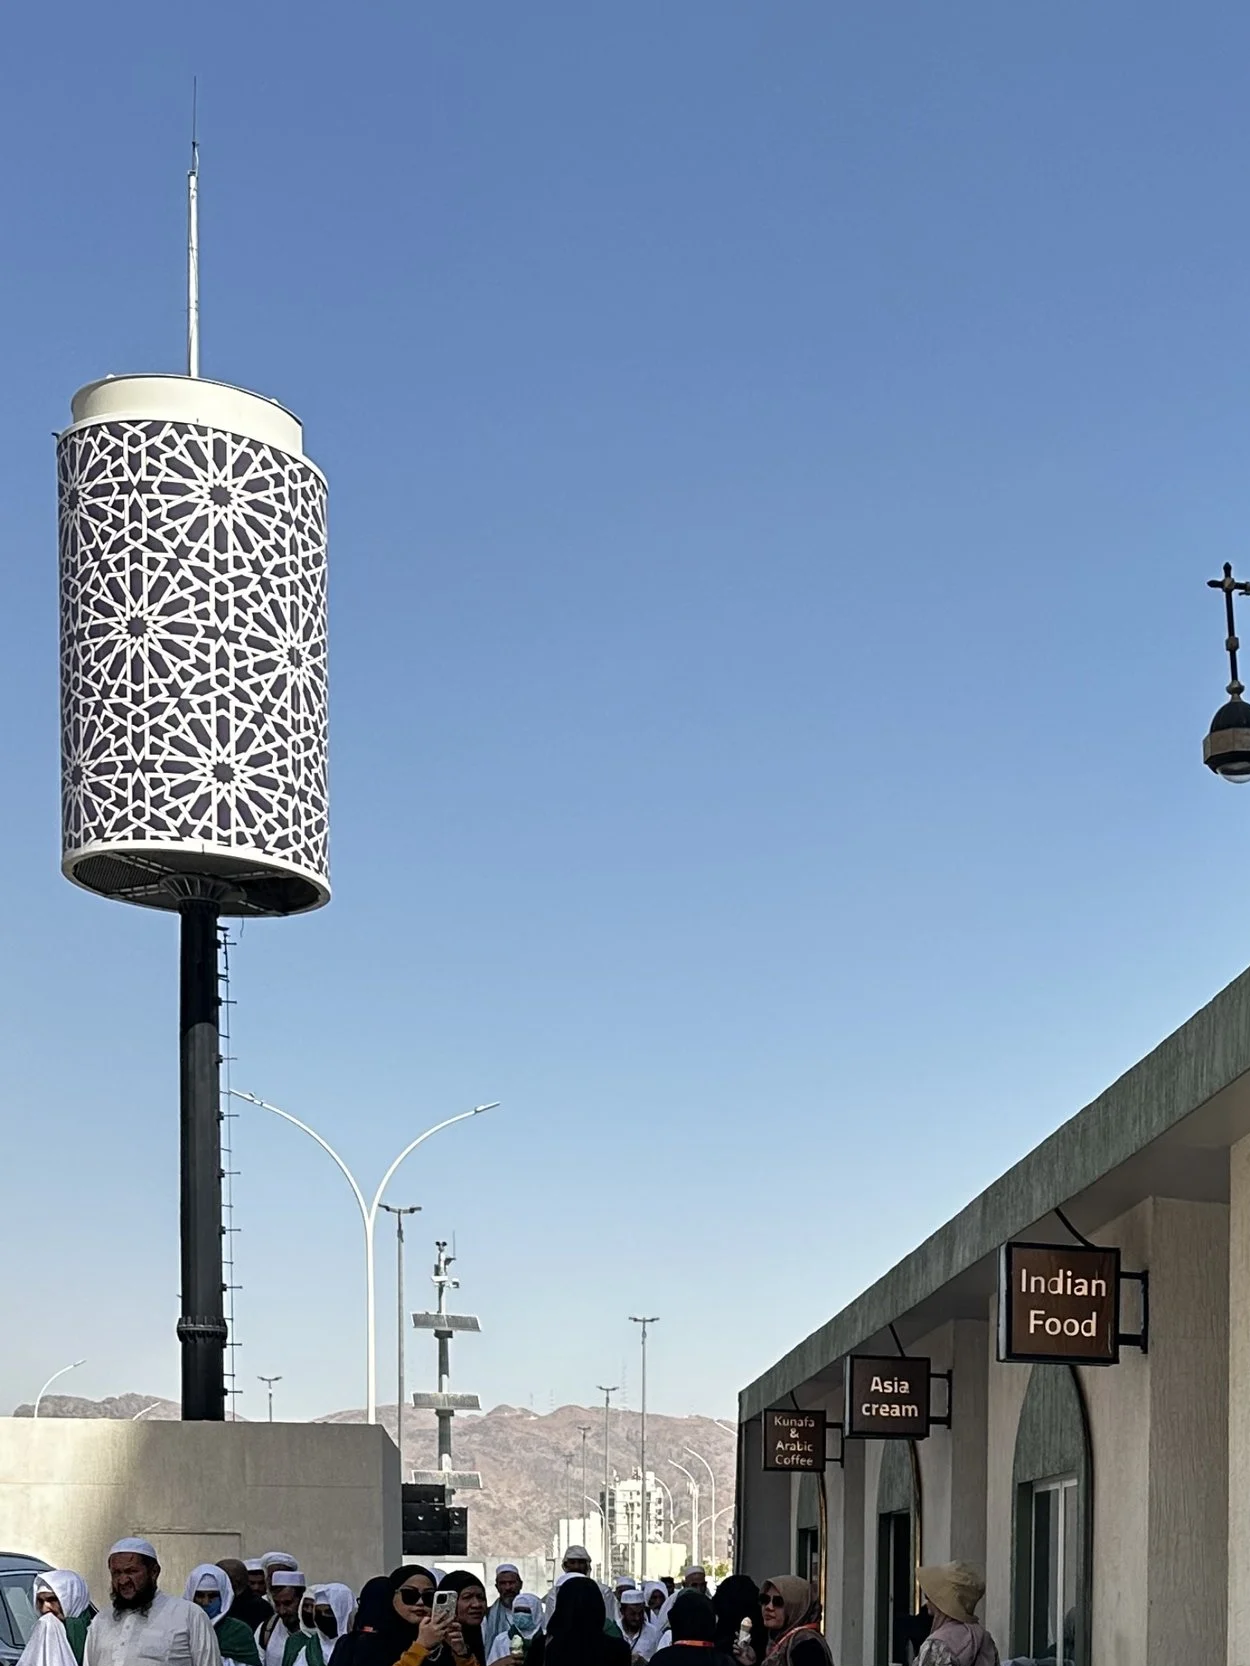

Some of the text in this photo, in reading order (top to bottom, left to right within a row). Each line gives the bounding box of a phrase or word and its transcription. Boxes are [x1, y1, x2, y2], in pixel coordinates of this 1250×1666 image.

[1021, 1268, 1106, 1297] Indian
[1029, 1309, 1097, 1337] Food
[870, 1376, 910, 1394] Asia
[861, 1403, 919, 1417] cream
[774, 1416, 815, 1428] Kunafa
[789, 1428, 799, 1439] &
[775, 1440, 813, 1452] Arabic
[775, 1454, 814, 1466] Coffee
